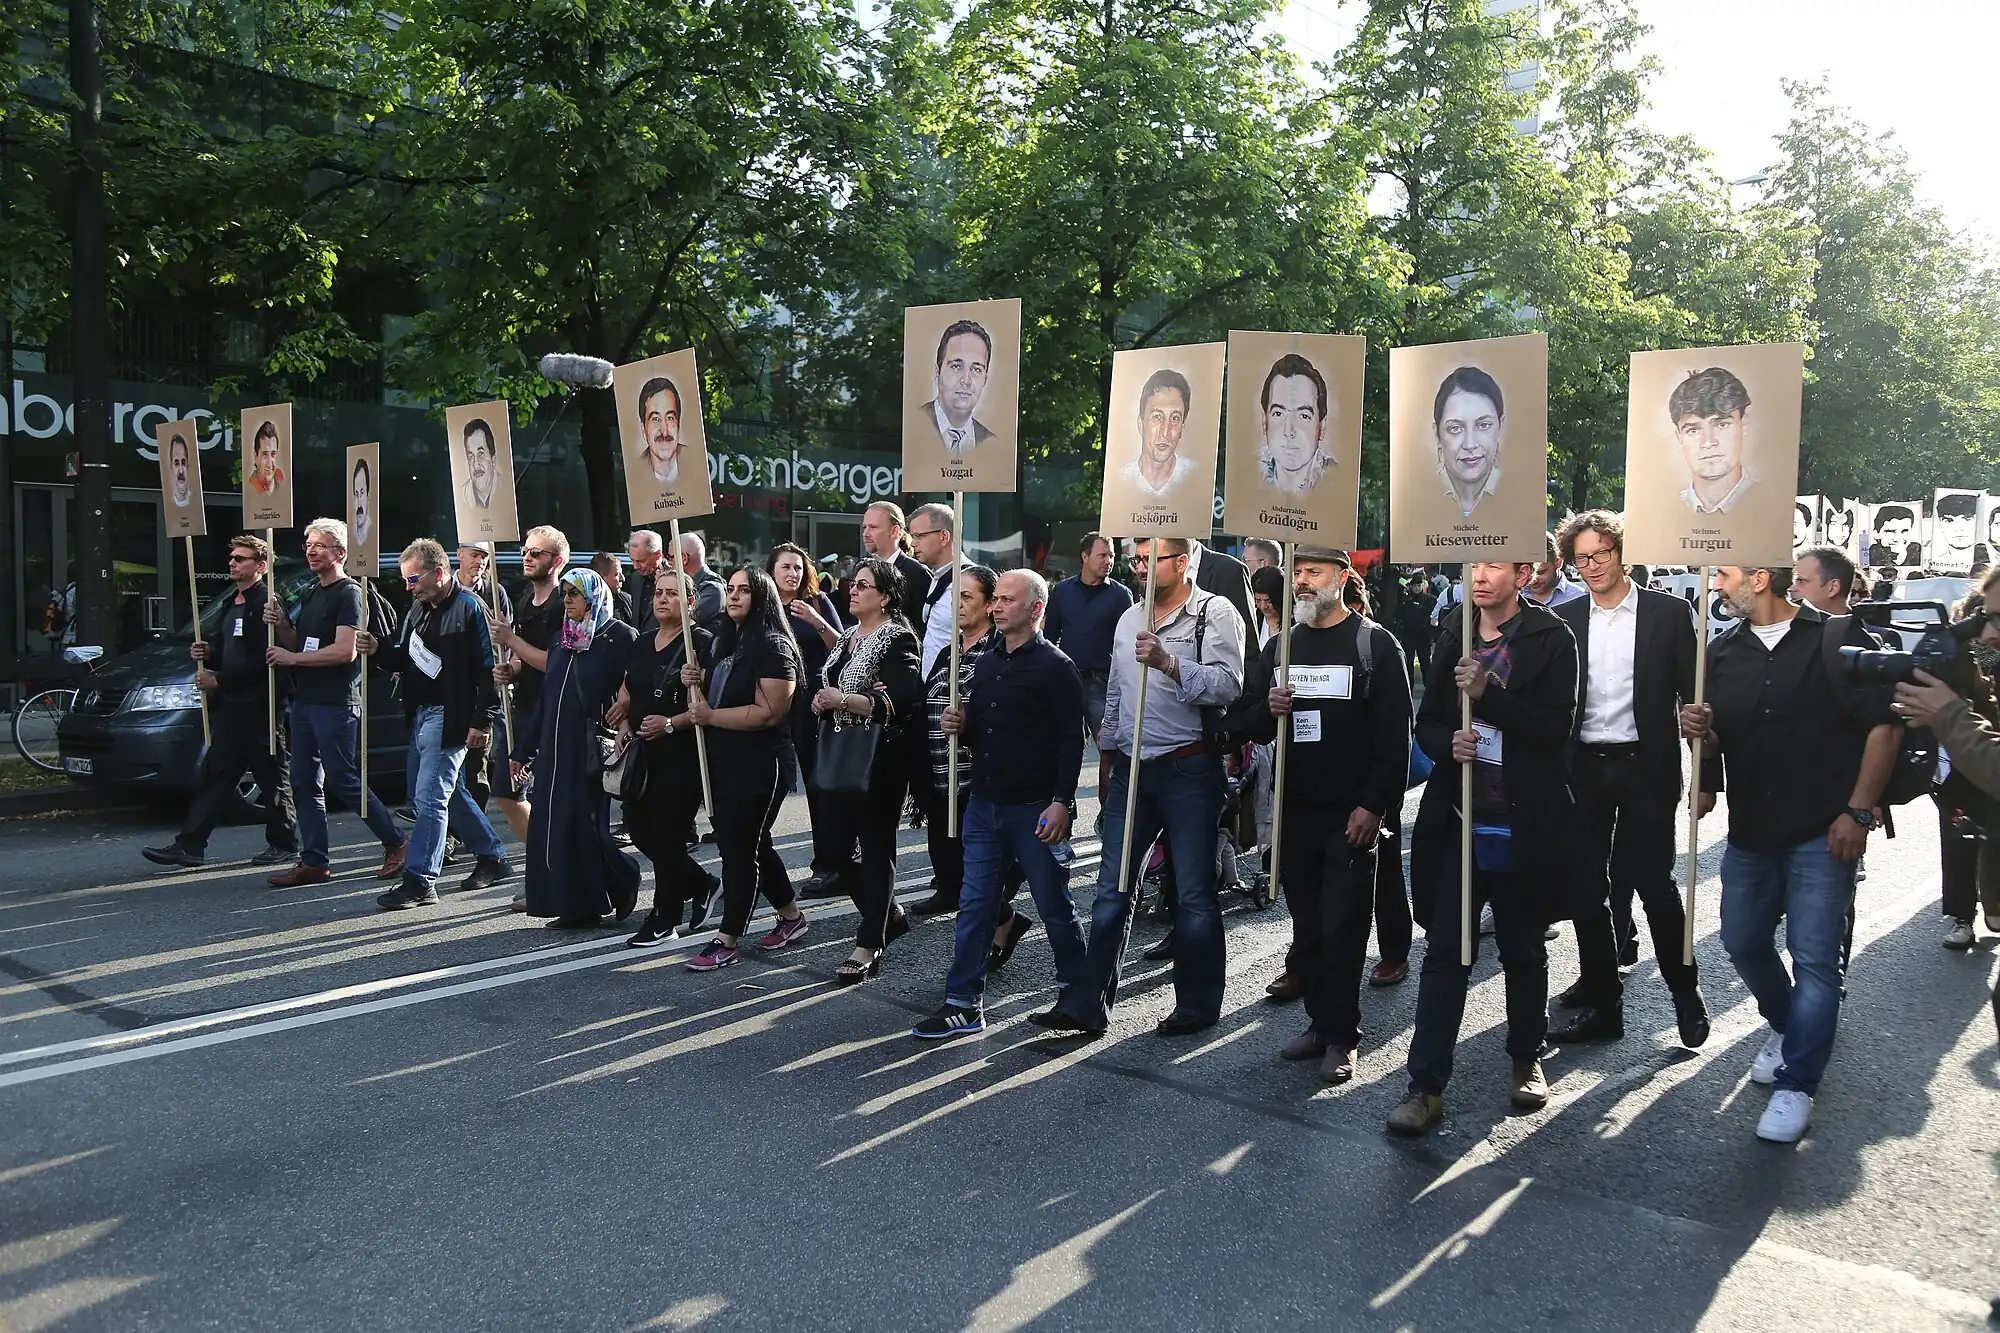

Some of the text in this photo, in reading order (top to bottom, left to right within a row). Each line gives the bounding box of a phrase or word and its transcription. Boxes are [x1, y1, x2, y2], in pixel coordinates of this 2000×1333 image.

[940, 467, 973, 480] Yozgat
[654, 496, 685, 510] Kubaşık
[1271, 505, 1307, 516] Abdurrahim
[1130, 513, 1178, 525] Taşköprü
[1259, 509, 1318, 532] Özüdoğru
[1425, 534, 1508, 547] Kiesewetter
[1680, 537, 1732, 552] Turgut
